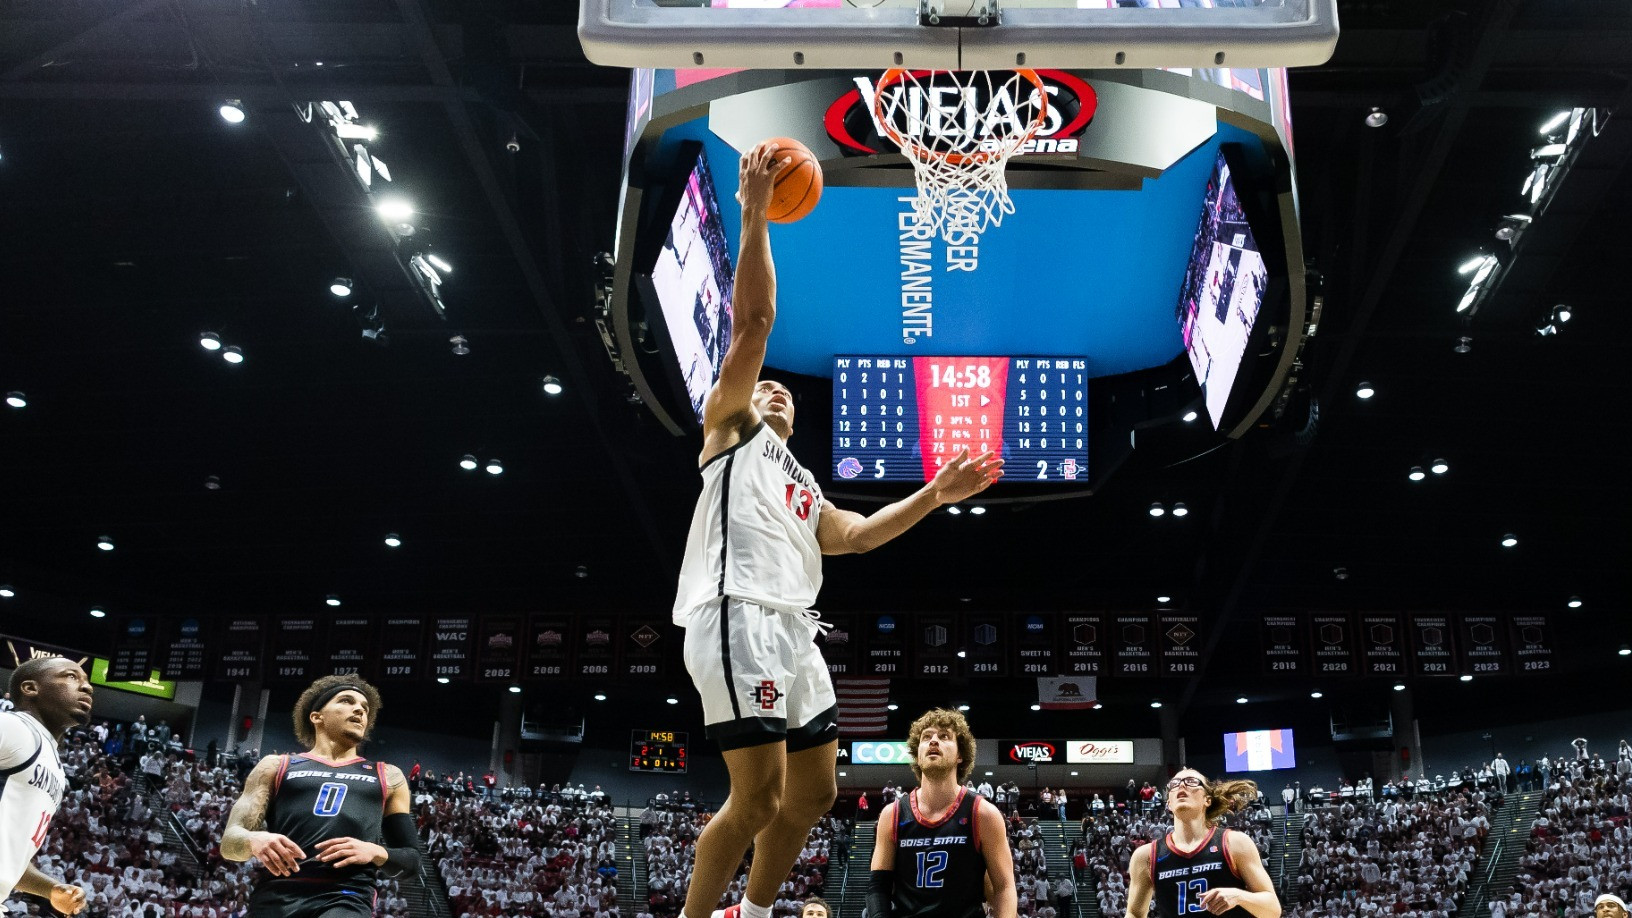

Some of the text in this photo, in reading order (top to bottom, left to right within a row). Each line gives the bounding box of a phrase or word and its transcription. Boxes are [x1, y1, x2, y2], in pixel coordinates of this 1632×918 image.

[853, 77, 1062, 151] VIEJAS
[837, 359, 906, 368] PLY PTS REB FLS
[1017, 360, 1085, 369] PLY PTS REB FLS
[840, 373, 902, 383] 0 2 1 1
[931, 365, 991, 388] 14:58
[1019, 374, 1081, 384] 4 0 1 1
[842, 389, 902, 399] 1 1 0 1
[1020, 390, 1082, 400] 5 0 1 0
[951, 395, 970, 407] 1ST
[841, 405, 903, 416] 2 0 2 0
[1018, 406, 1082, 417] 12 0 0 0
[935, 415, 942, 425] 0
[981, 415, 987, 425] 0
[839, 421, 903, 432] 12 2 1 0
[1019, 422, 1082, 433] 13 2 1 0
[933, 429, 944, 438] 17
[952, 430, 961, 438] FG
[980, 429, 990, 438] 11
[839, 438, 902, 448] 13 0 0 0
[933, 443, 944, 452] 75
[952, 444, 960, 452] FT
[981, 442, 987, 452] 0
[1019, 438, 1082, 449] 14 0 1 0
[763, 440, 783, 463] SAN
[935, 457, 942, 466] 4
[875, 460, 885, 478] 5
[1037, 461, 1047, 479] 2
[785, 483, 812, 520] 13
[435, 632, 467, 641] WAC
[386, 666, 411, 674] 1978
[437, 666, 460, 674] 1985
[534, 666, 560, 674] 2006
[630, 665, 656, 673] 2009
[875, 664, 896, 672] 2011
[924, 665, 948, 673] 2012
[974, 664, 997, 672] 2014
[1024, 664, 1047, 672] 2014
[1074, 663, 1098, 671] 2015
[1123, 664, 1148, 672] 2016
[1170, 664, 1194, 672] 2016
[1272, 662, 1296, 670] 2018
[1322, 663, 1347, 671] 2020
[1374, 663, 1396, 671] 2021
[1424, 663, 1446, 671] 2021
[1474, 663, 1499, 671] 2023
[1525, 661, 1549, 670] 2023
[227, 668, 250, 677] 1941
[279, 667, 303, 675] 1976
[485, 669, 510, 677] 2002
[651, 732, 673, 741] 14:58
[641, 746, 648, 756] 2
[679, 748, 685, 758] 5
[857, 743, 915, 762] COX
[1015, 745, 1049, 761] VIEJAS
[28, 764, 50, 790] SAN
[287, 771, 377, 783] BOISE STATE
[313, 782, 348, 816] 0
[900, 836, 967, 847] BOISE STATE
[916, 851, 948, 888] 12
[1159, 862, 1222, 880] BOISE STATE
[1176, 878, 1208, 915] 13
